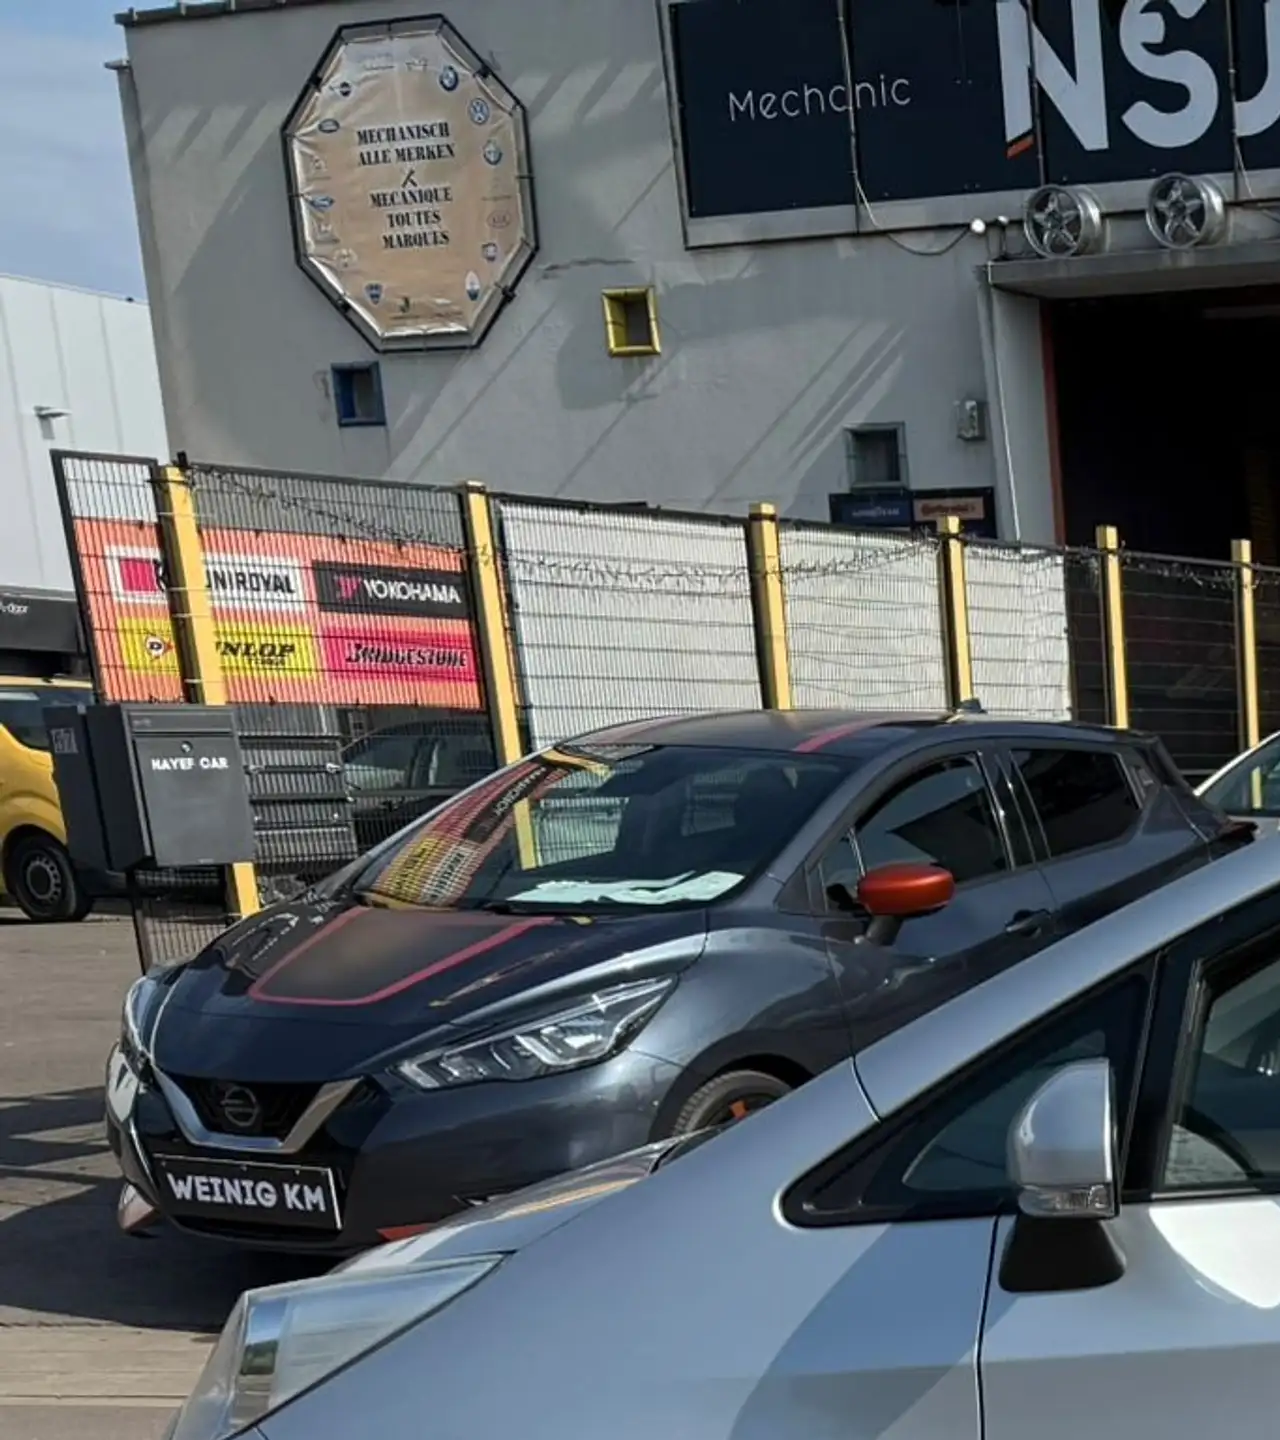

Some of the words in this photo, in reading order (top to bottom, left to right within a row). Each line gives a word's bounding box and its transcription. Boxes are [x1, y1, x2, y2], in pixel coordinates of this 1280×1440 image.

[729, 74, 911, 122] Mechanic
[356, 121, 450, 145] MECHANISCH
[358, 149, 392, 167] ALLE
[395, 143, 456, 164] MERKEN
[370, 187, 454, 208] MECANIQUE
[387, 210, 442, 228] TOUTES
[382, 230, 450, 250] MARQUES
[206, 567, 296, 594] NIROYAL
[364, 579, 462, 604] YOKOHAMA
[152, 757, 194, 772] NAYEF
[200, 756, 229, 770] CAR
[167, 1173, 277, 1208] WEINIG
[283, 1183, 326, 1212] KM
